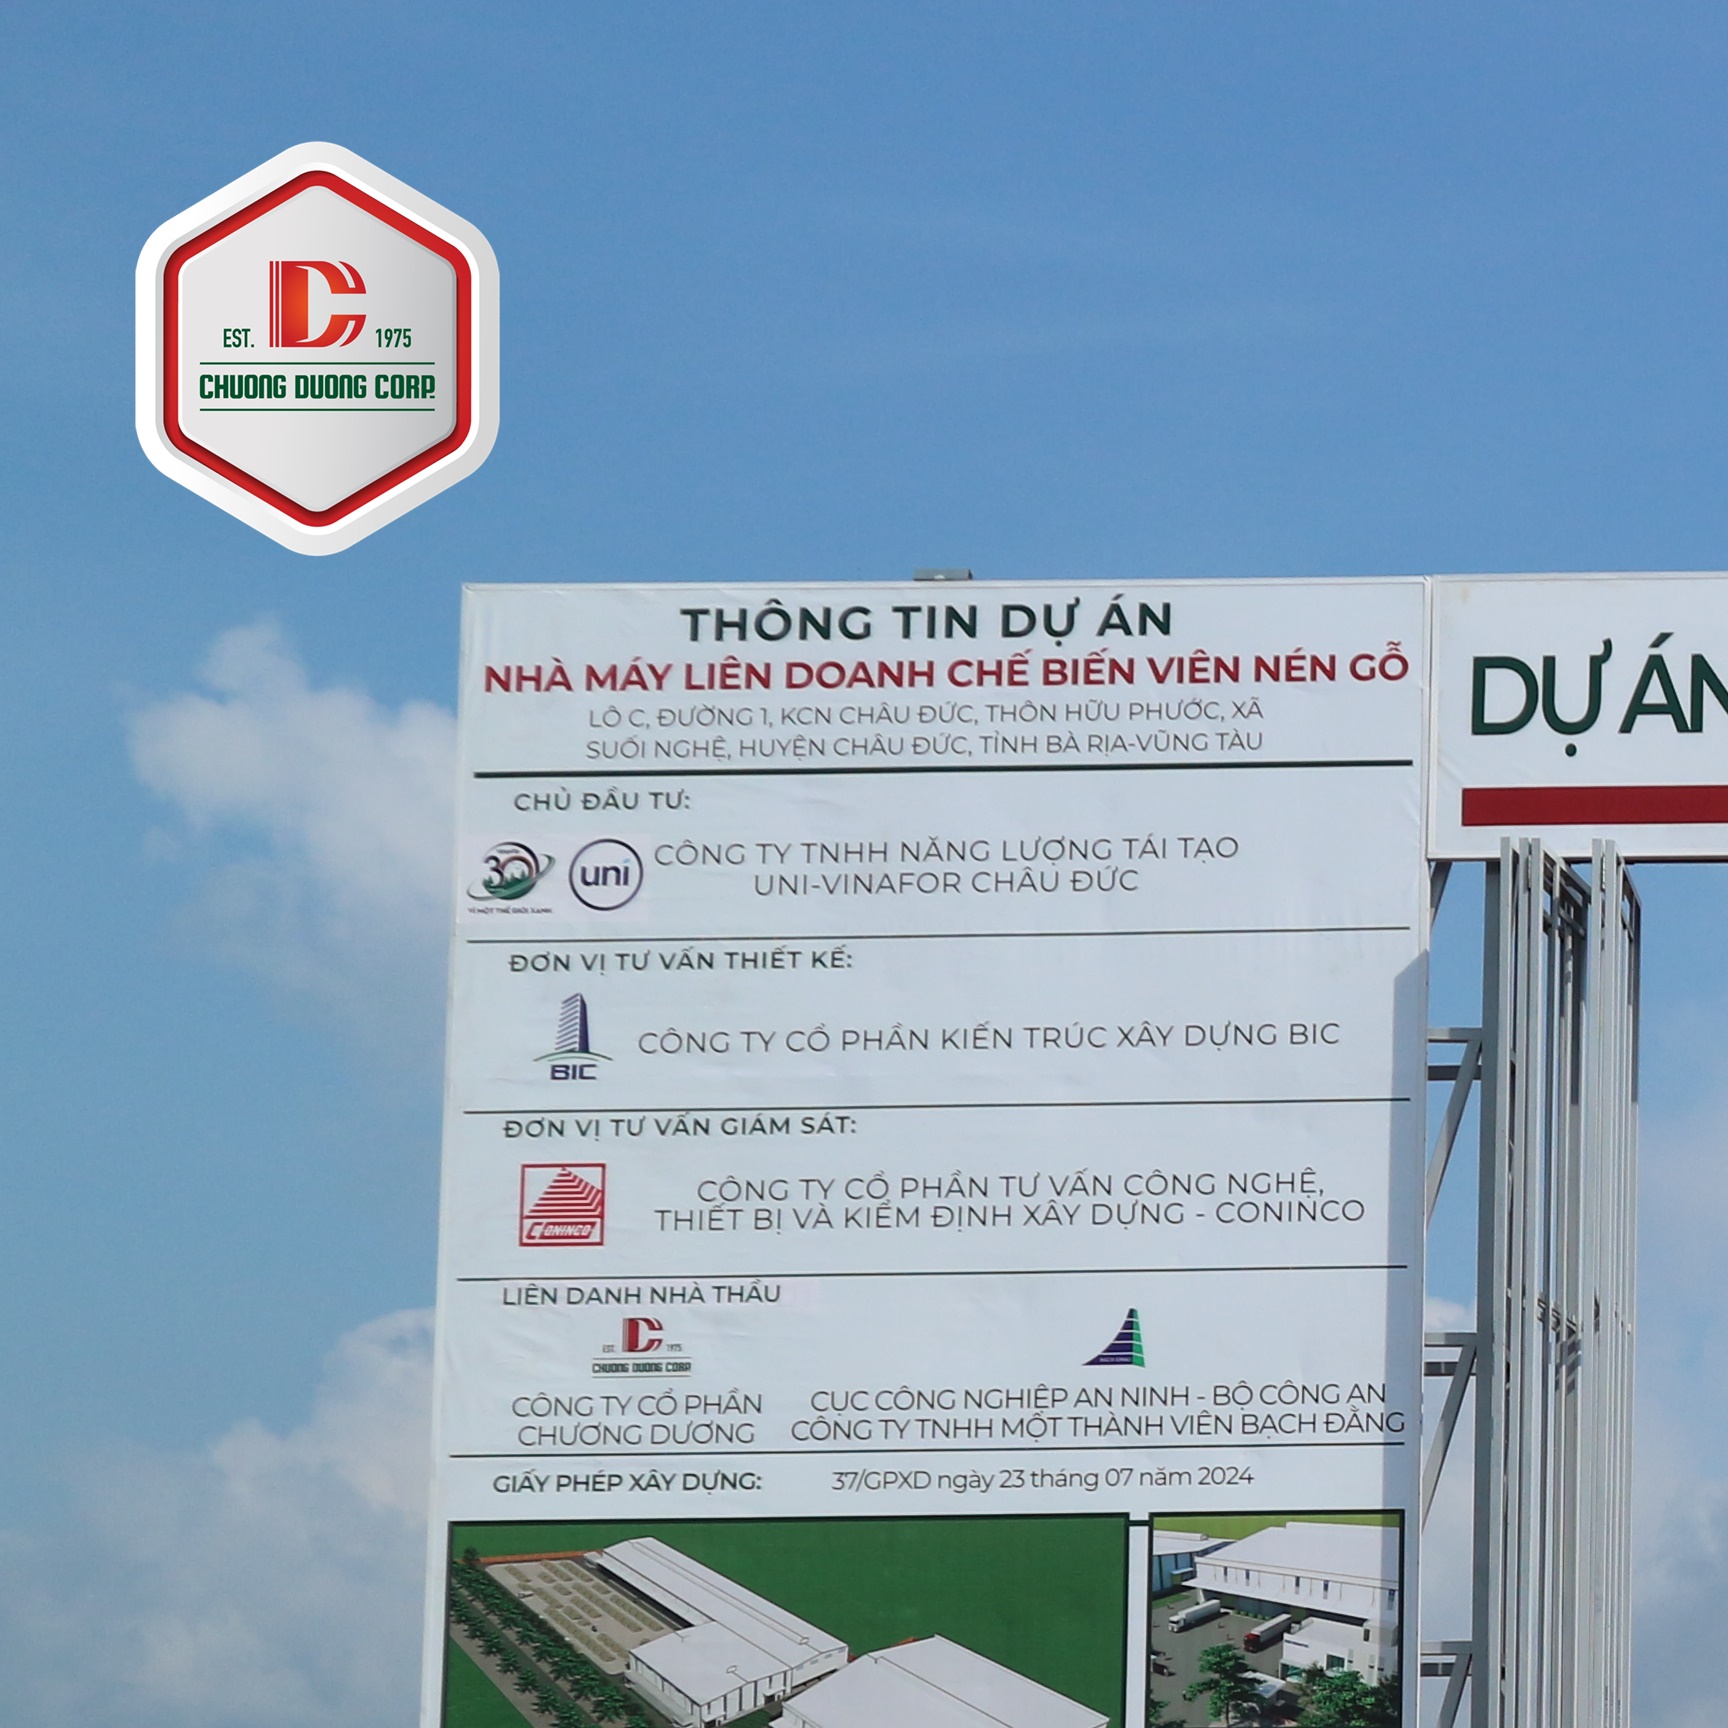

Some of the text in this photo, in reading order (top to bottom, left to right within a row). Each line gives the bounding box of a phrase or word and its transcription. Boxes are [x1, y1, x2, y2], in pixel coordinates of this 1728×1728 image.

[680, 594, 1170, 644] THÔNG TIN DỰ ÁN
[1472, 637, 1612, 757] DỰ
[514, 786, 690, 811] CHỦ ĐẦU TƯ:
[655, 833, 1238, 866] CÔNG TY TNHH NĂNG LƯỢNG TÁI TẠO
[581, 858, 630, 886] uni
[755, 866, 1138, 896] UNI-VINAFOR CHÂU ĐỨC
[503, 1279, 780, 1305] LIÊN DANH NHÀ THẦU
[493, 1469, 761, 1493] GIẤY PHÉP XÂY DỰNG:
[832, 1467, 1254, 1493] 37/GPXD ngày 23 tháng 07 năm 2024
